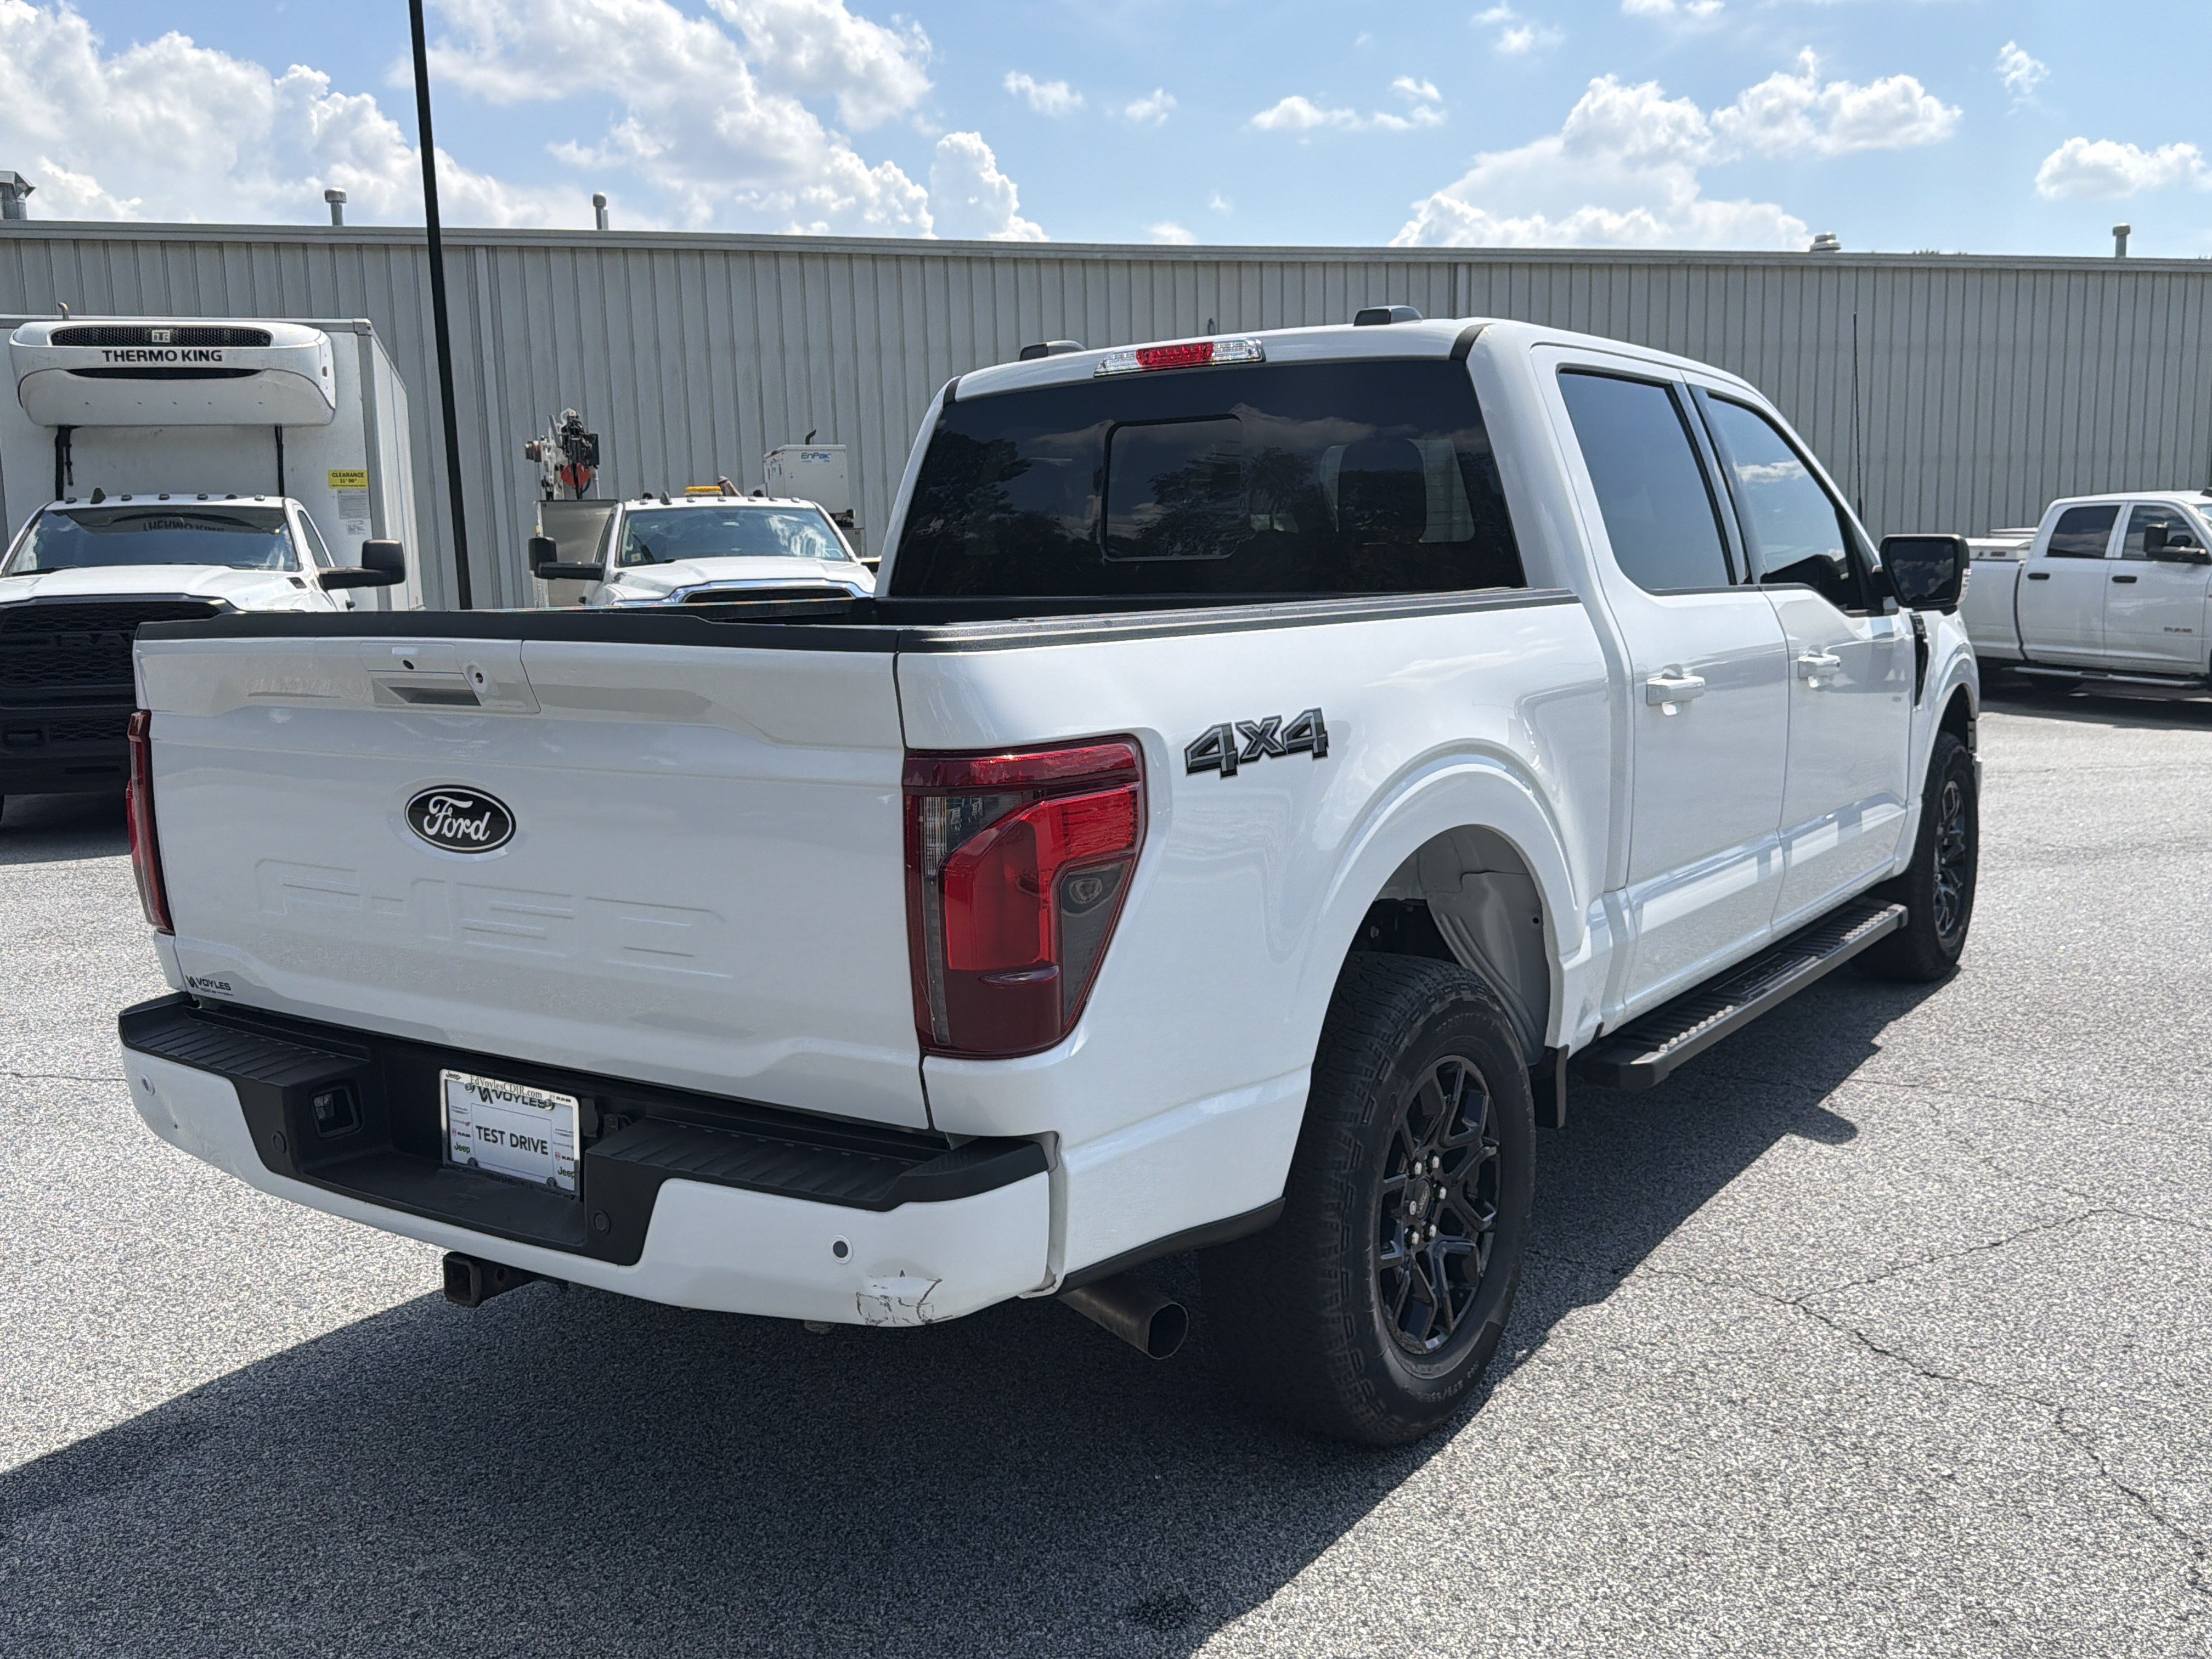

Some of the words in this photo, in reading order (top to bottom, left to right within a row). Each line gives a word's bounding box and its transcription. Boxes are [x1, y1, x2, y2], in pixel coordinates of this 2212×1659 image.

[101, 350, 177, 362] THERMO
[181, 350, 223, 362] KING
[424, 796, 492, 841] Ford
[195, 977, 232, 991] VOYLES
[446, 1071, 460, 1080] Jeep
[470, 1075, 543, 1099] EdVoylesCDJR.com
[475, 1125, 506, 1146] TEST
[510, 1132, 549, 1155] DRIVE
[454, 1142, 471, 1155] Jeep
